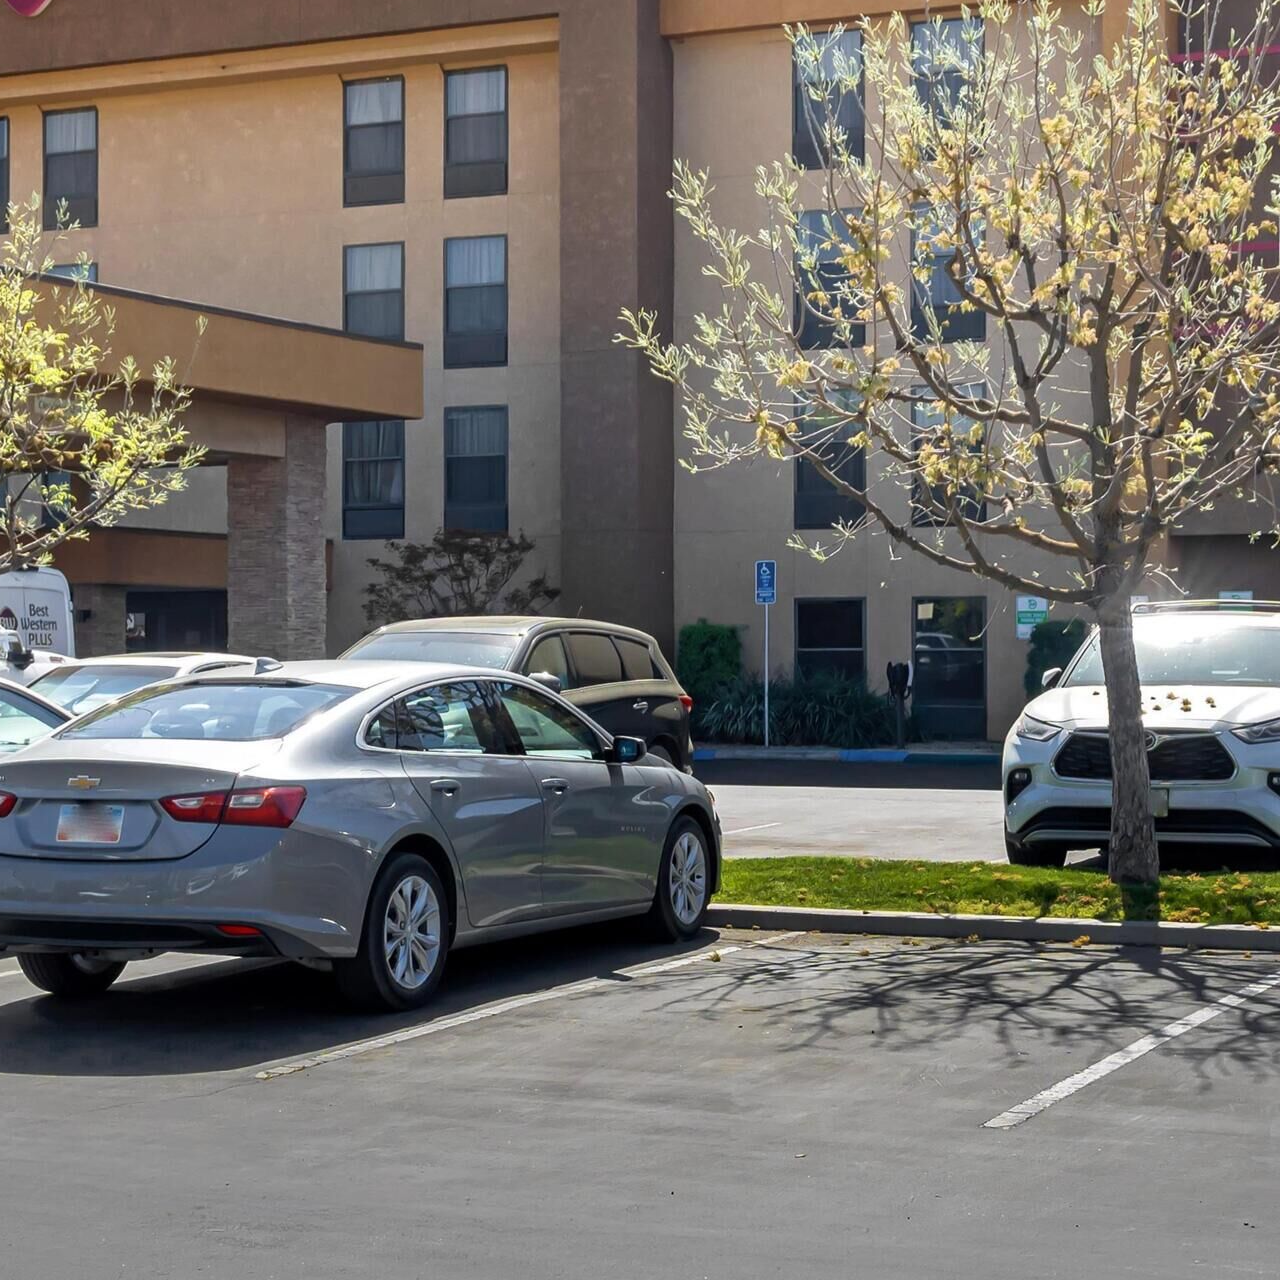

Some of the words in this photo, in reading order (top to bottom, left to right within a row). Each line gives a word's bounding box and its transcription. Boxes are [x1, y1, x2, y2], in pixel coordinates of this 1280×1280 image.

[29, 603, 49, 617] Best
[0, 616, 17, 629] BW
[21, 617, 58, 631] Western
[28, 632, 53, 646] PLUS
